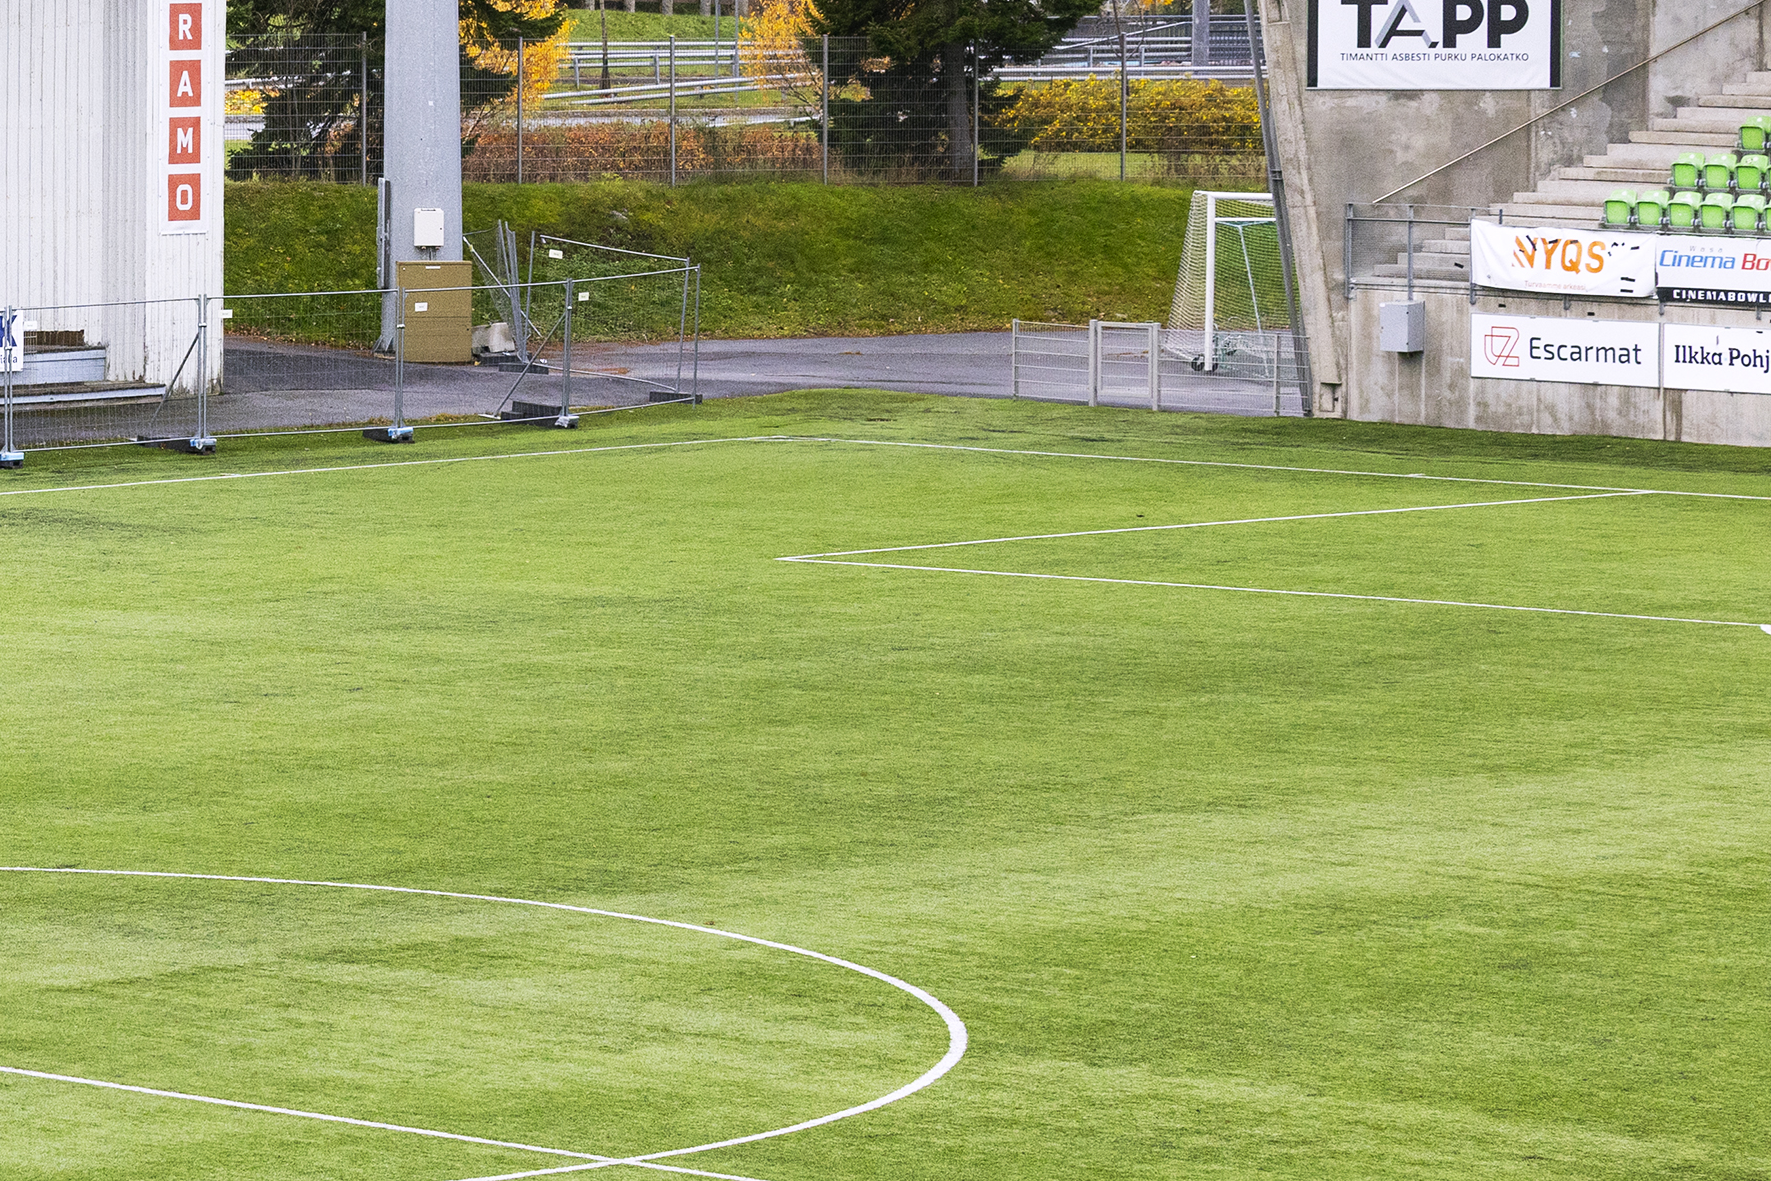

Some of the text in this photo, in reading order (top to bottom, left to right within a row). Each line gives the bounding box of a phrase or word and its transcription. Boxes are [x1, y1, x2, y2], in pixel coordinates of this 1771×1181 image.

[1340, 52, 1530, 61] TIMANTTI ASBESTI PURKU PALOKATKO
[1659, 249, 1771, 271] Cinema Bo
[1689, 245, 1723, 254] Wasa
[1529, 336, 1642, 366] Escarmat
[1674, 344, 1770, 374] Ilkka Pohj
